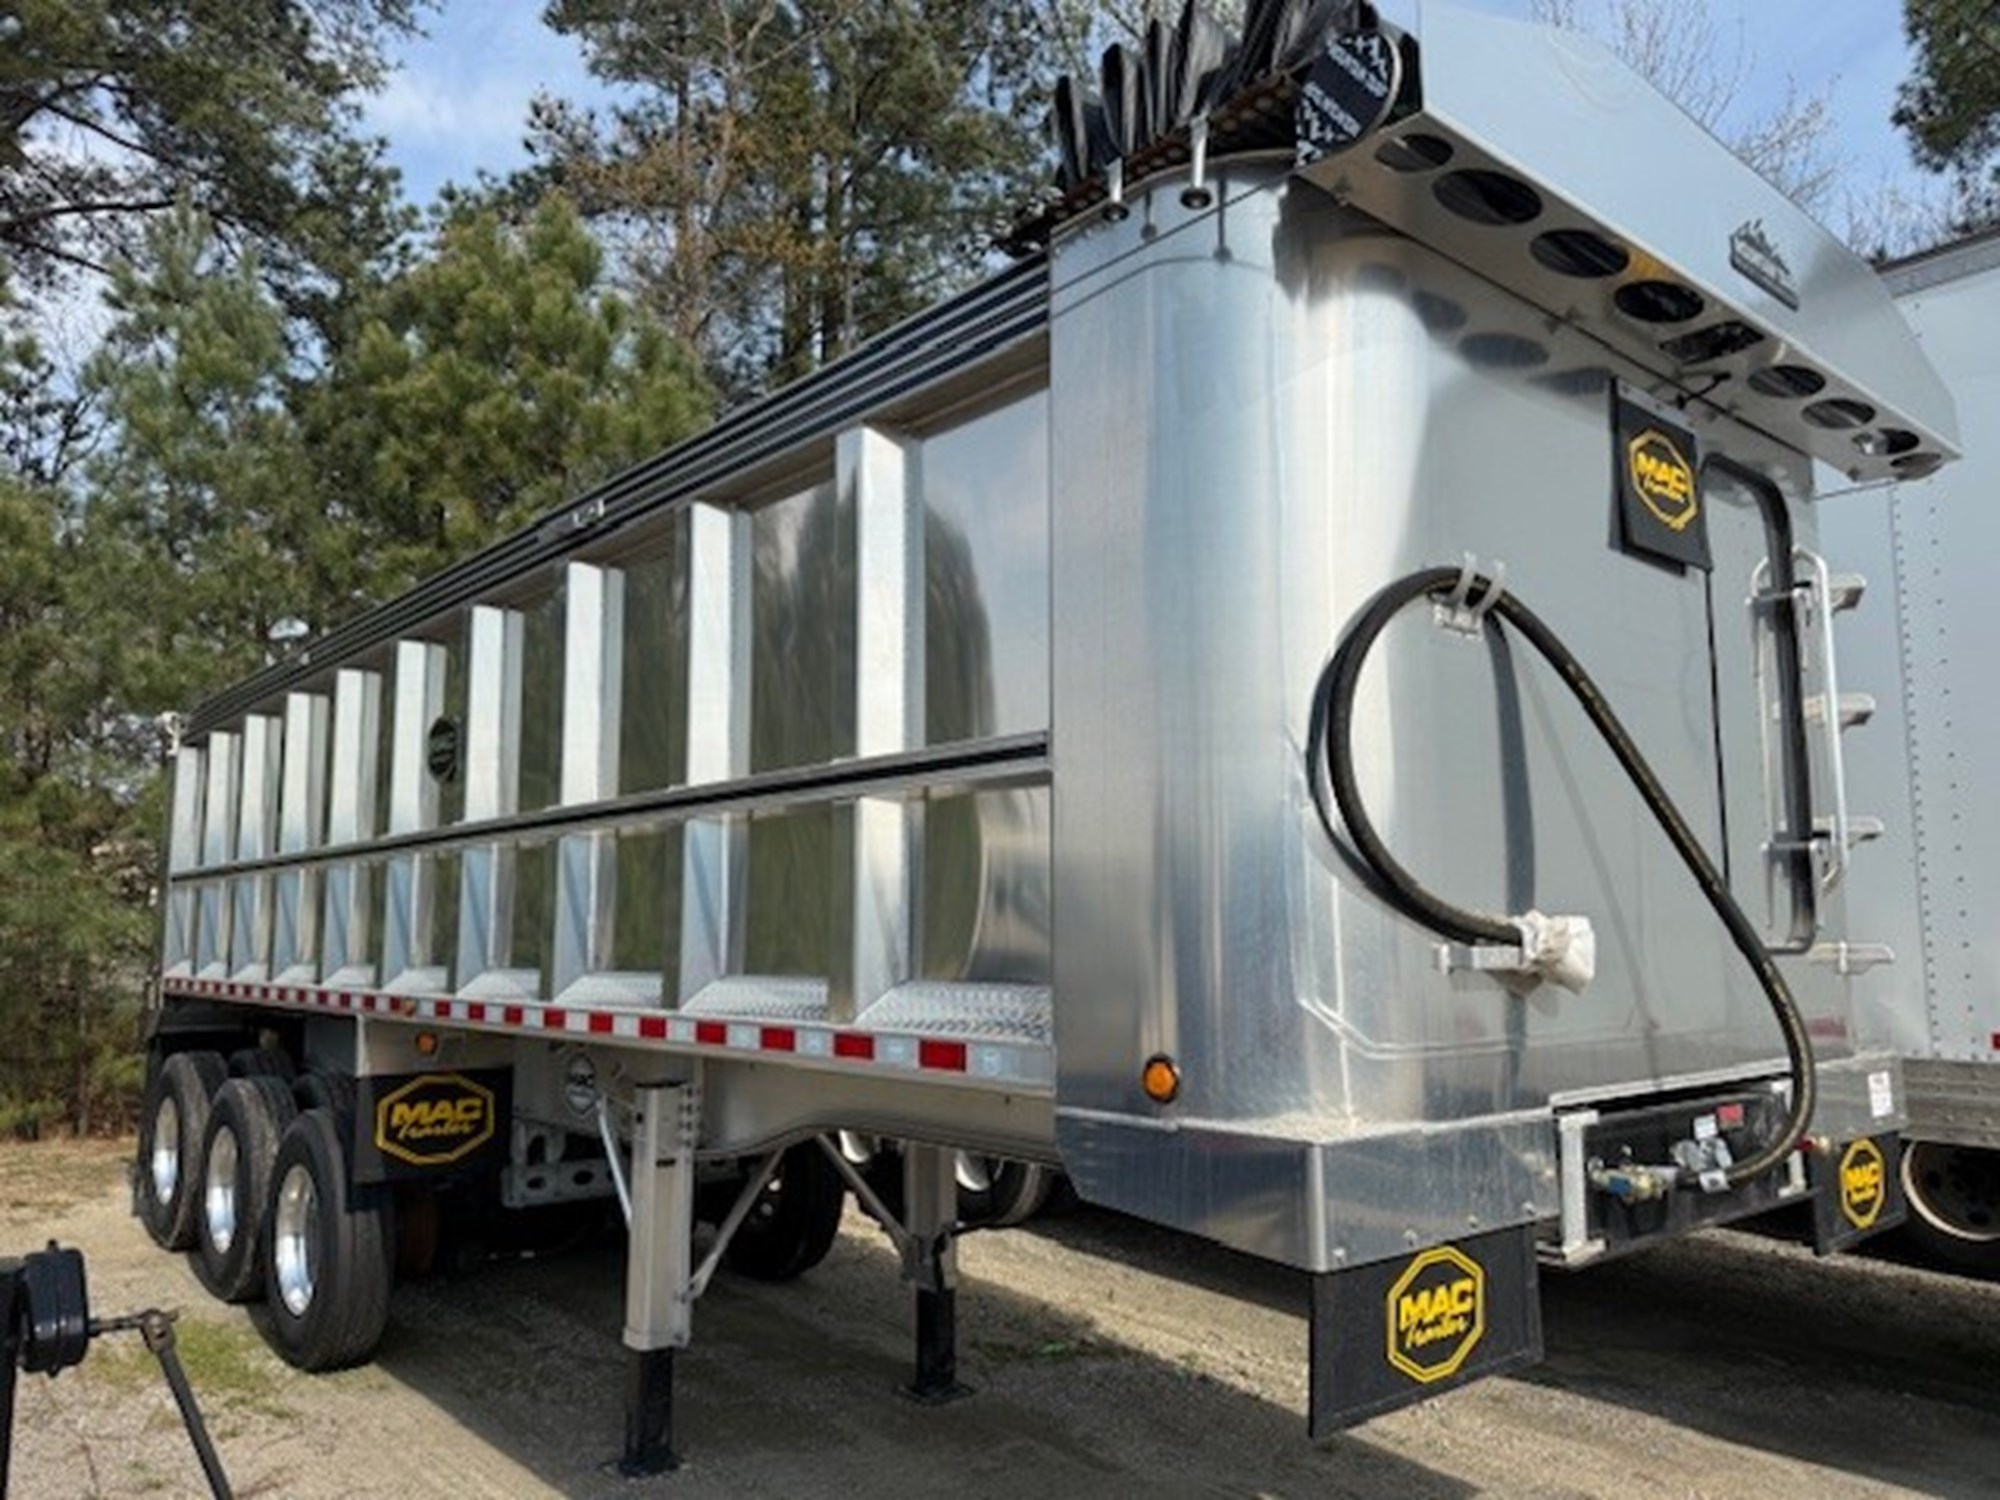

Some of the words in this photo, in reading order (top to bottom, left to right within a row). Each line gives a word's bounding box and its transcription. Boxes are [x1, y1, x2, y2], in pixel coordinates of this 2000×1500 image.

[1635, 450, 1689, 493] MAC
[390, 1097, 484, 1128] MAC
[1399, 1278, 1475, 1332] MAC
